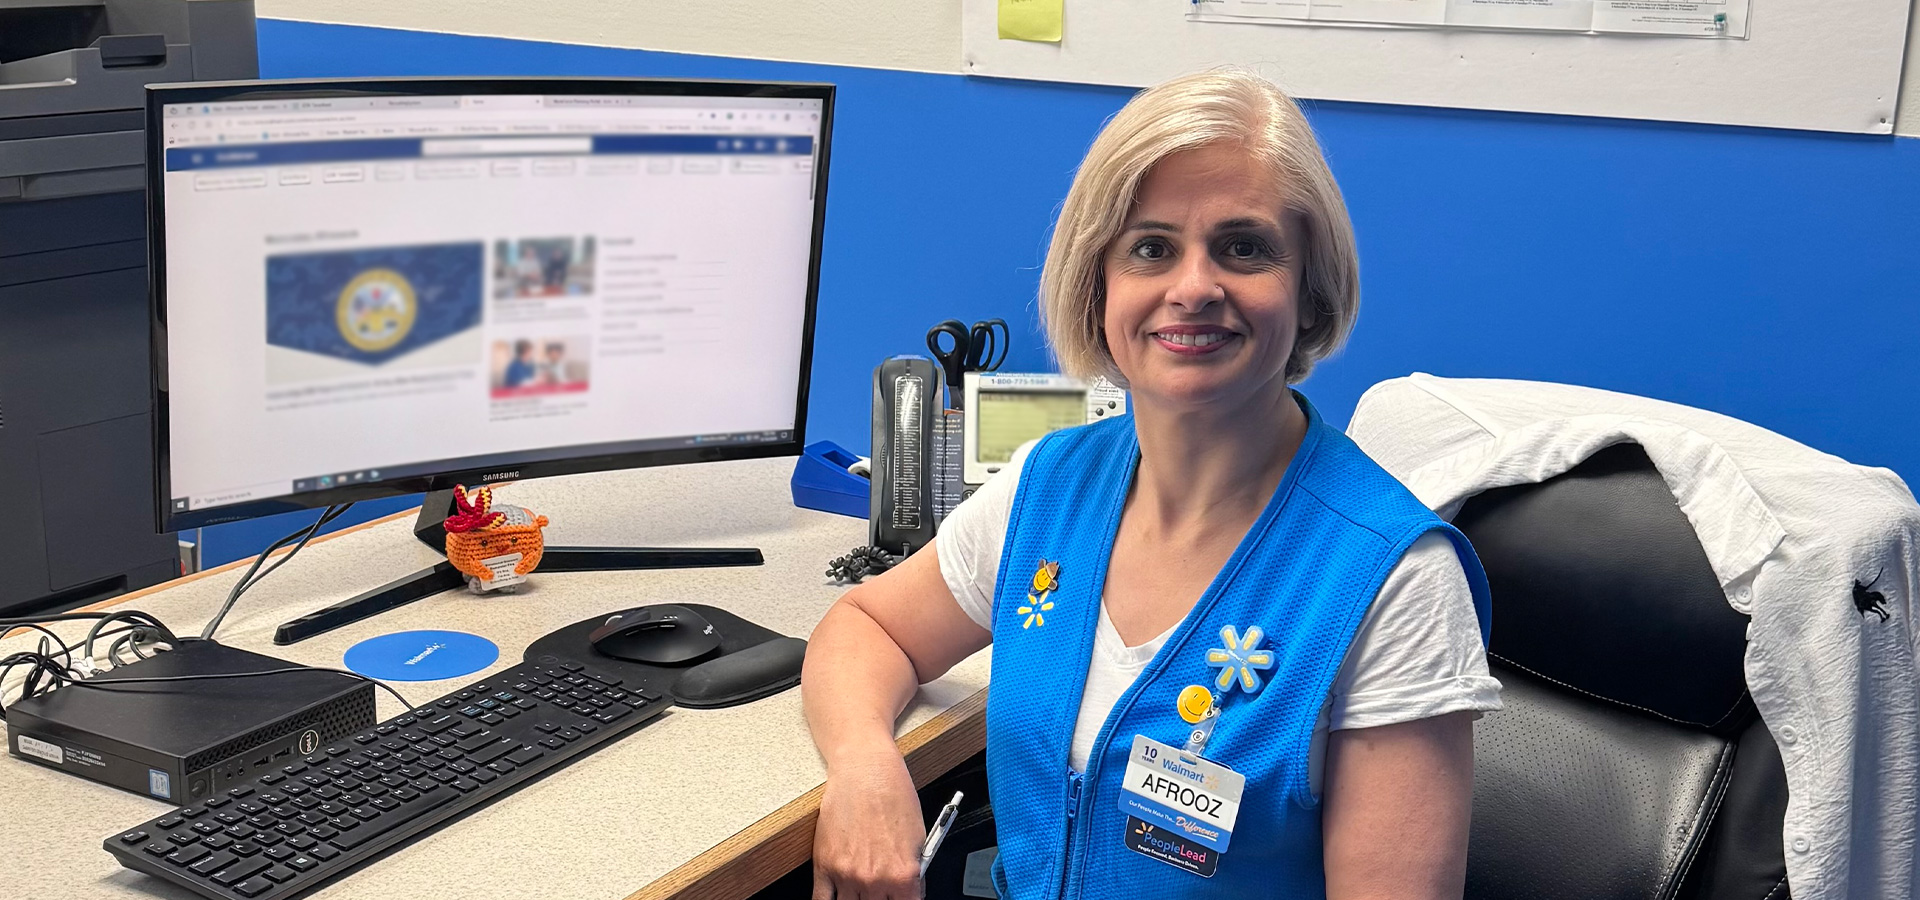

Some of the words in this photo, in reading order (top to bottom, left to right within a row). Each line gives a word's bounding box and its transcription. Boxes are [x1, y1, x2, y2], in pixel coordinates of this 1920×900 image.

[482, 470, 520, 482] SAMSUNG
[404, 643, 441, 665] Walmart
[1141, 755, 1155, 764] YEARS
[1144, 745, 1158, 759] 10
[1162, 758, 1205, 783] Walmart
[1141, 773, 1223, 819] AFROOZ
[1175, 816, 1219, 838] Difference
